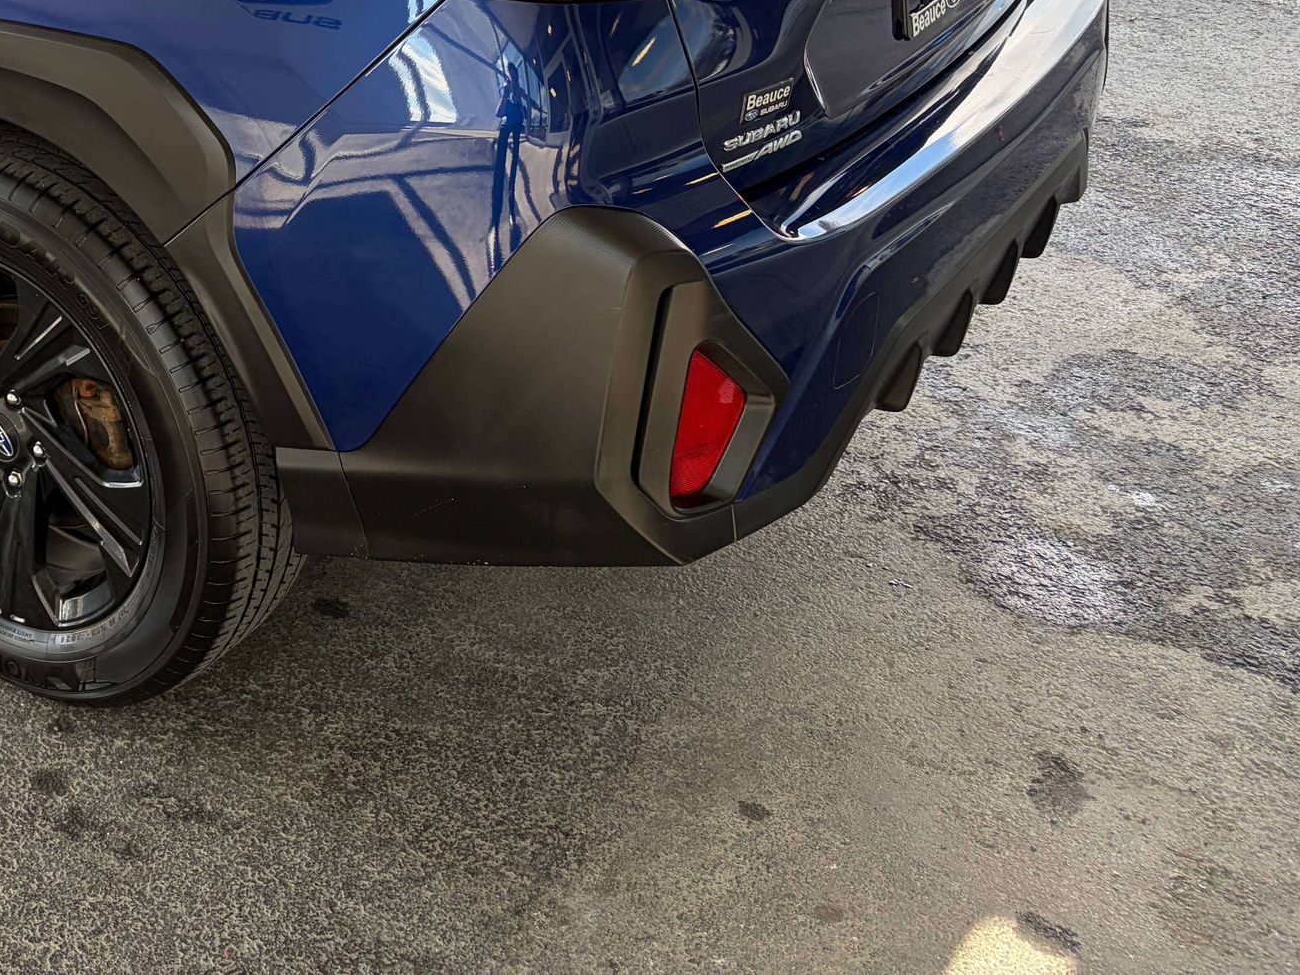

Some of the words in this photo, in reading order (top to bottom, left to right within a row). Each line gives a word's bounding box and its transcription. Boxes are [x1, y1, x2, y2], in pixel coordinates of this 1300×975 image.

[746, 85, 791, 111] Beauce
[760, 100, 788, 116] SUBARU
[722, 110, 801, 152] SUBARU
[753, 129, 803, 161] AWD
